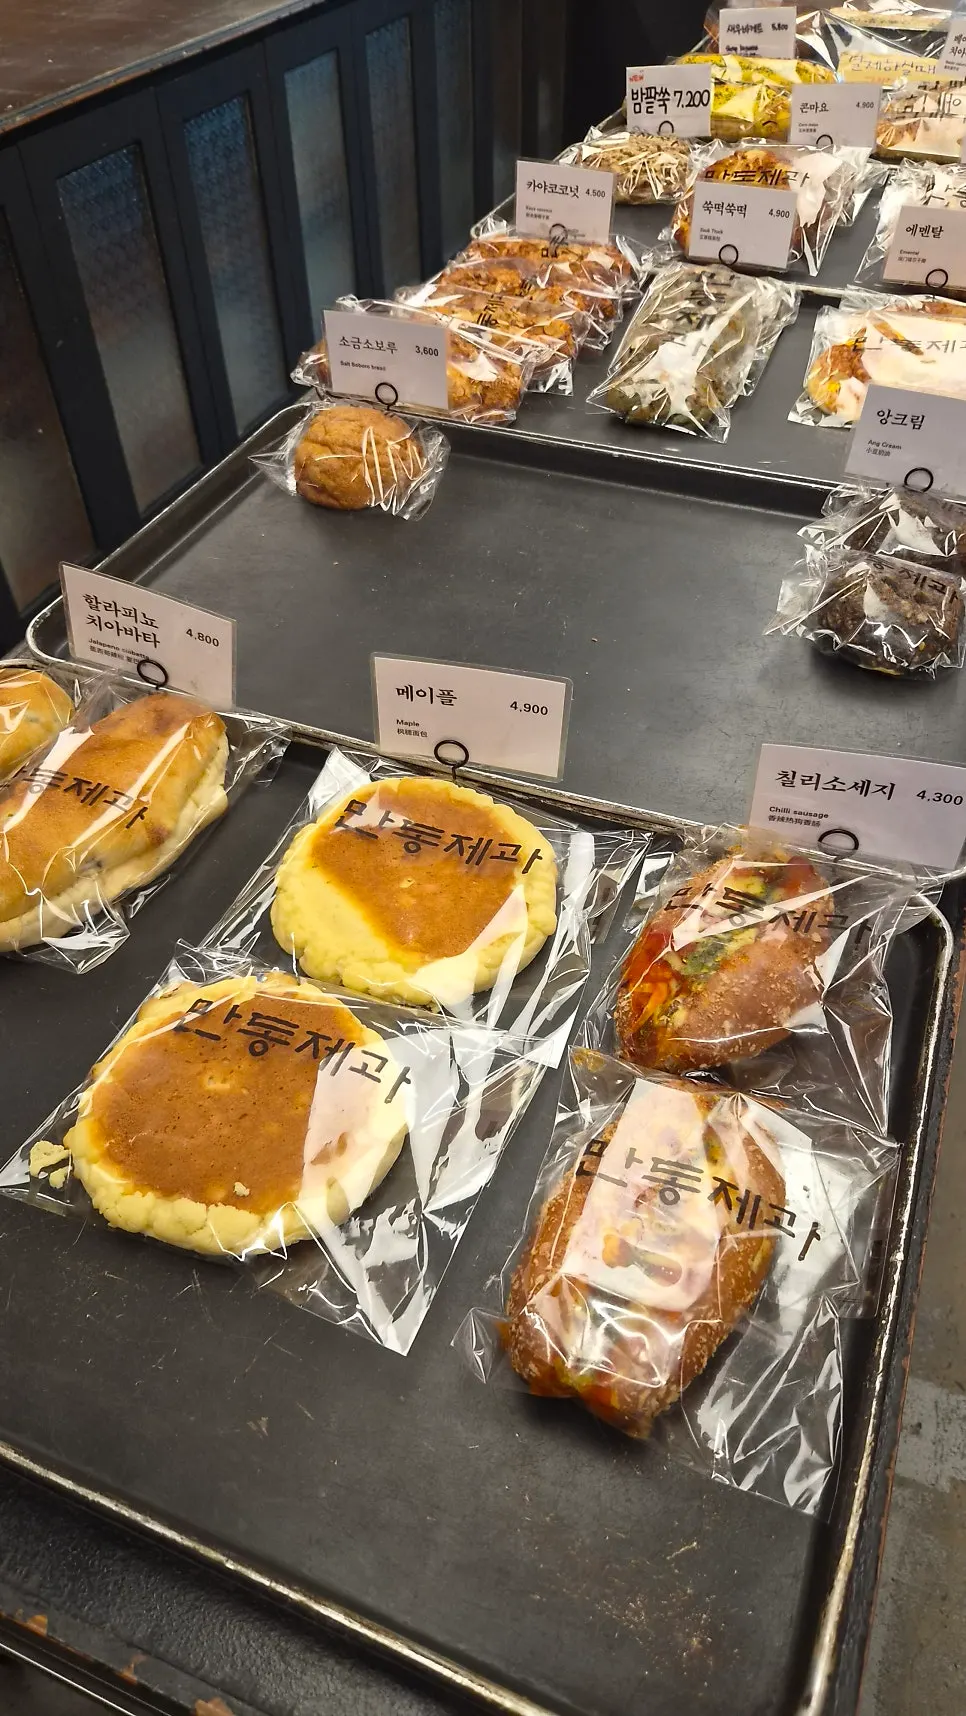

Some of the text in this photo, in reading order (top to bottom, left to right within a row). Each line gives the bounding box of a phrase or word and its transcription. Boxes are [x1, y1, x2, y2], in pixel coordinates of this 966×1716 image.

[631, 86, 671, 114] 밤팥쑥
[799, 102, 830, 114] 콘마요
[525, 179, 580, 199] 카야코코넛
[701, 200, 748, 218] 쑥떡쑥떡
[905, 224, 945, 239] 에멘탈
[338, 335, 398, 355] 소금소보루
[876, 408, 926, 431] 앙크림
[867, 439, 902, 450] Ang Cream
[82, 593, 159, 629] 할라피뇨
[86, 614, 161, 649] 치아바타
[395, 683, 458, 707] 메이플
[396, 718, 420, 728] Maple
[775, 769, 896, 801] 칠리소세지
[769, 805, 829, 819] Chilli sausage
[333, 798, 545, 876] 만동제과
[172, 997, 413, 1105] 만동제과
[574, 1137, 822, 1262] 만동제과
